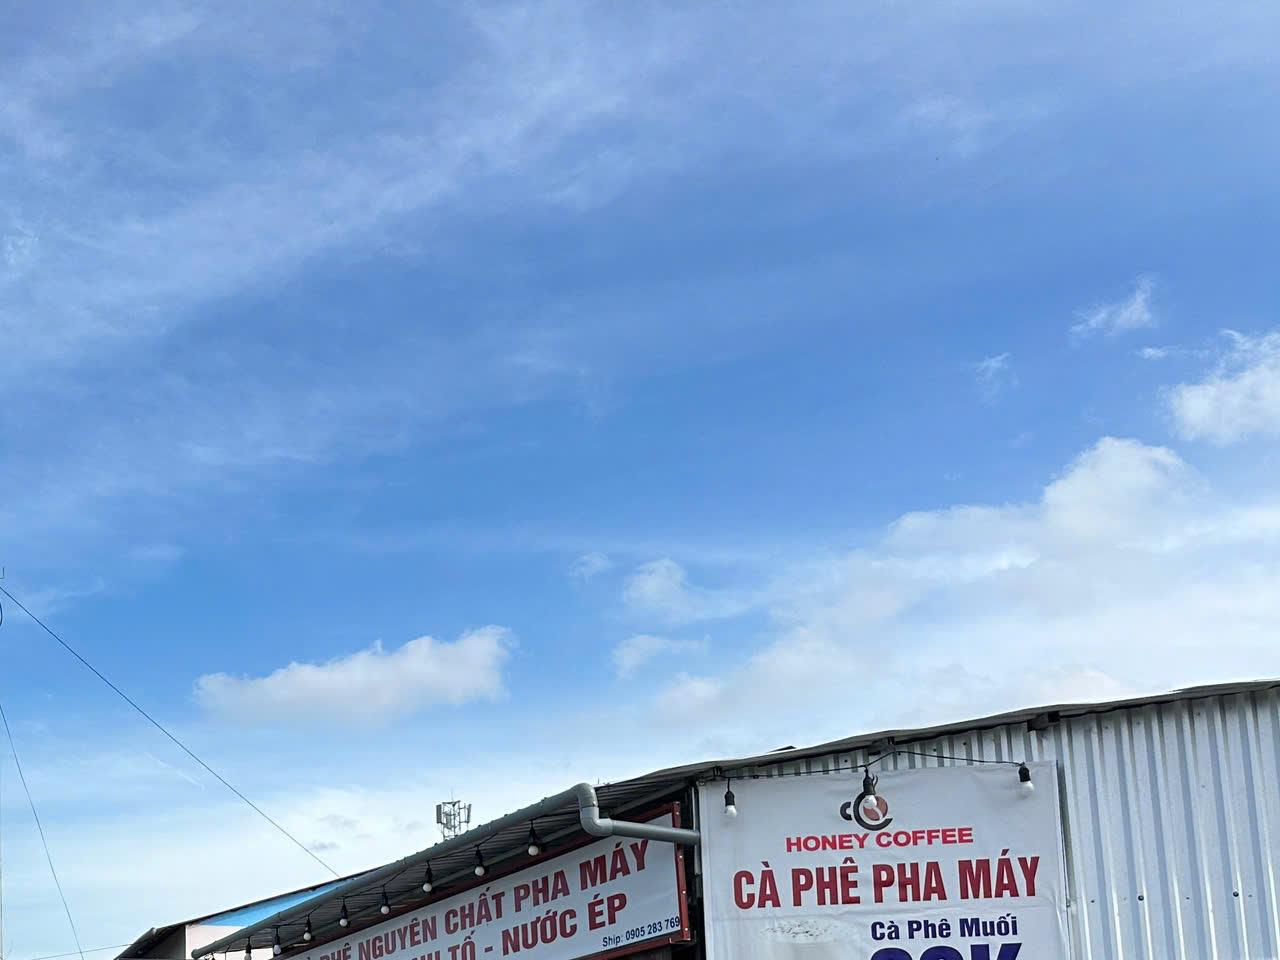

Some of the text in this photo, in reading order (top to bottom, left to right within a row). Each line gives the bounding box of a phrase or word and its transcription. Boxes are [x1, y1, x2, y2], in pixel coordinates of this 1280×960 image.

[786, 827, 974, 853] HONEY COFFEE
[444, 887, 505, 935] CHẤT
[513, 869, 570, 912] PHA
[578, 839, 649, 891] MÁY
[733, 848, 1040, 910] CÀ PHÊ PHA MÁY
[501, 908, 577, 956] NƯỚC
[587, 893, 627, 931] ÉP
[602, 915, 681, 948] Ship: 0905 283 769
[871, 912, 1018, 941] Cà Phê Muối
